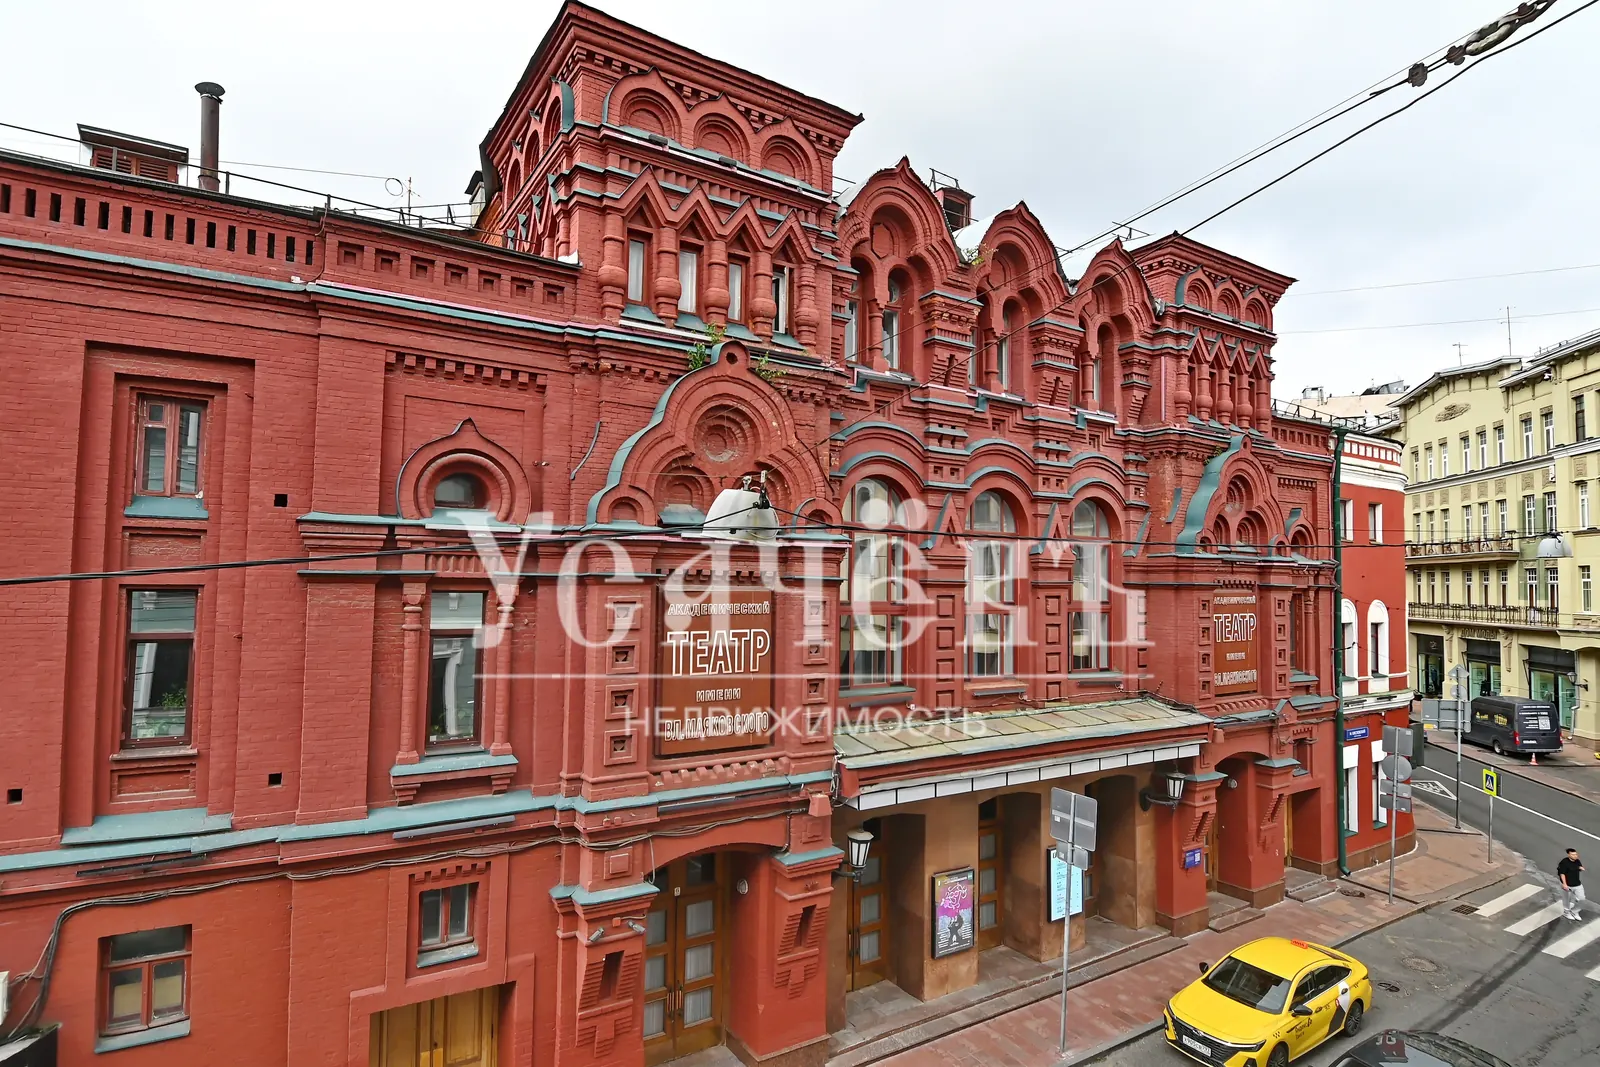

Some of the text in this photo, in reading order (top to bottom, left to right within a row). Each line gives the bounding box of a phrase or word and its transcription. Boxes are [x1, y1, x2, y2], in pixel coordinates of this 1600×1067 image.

[667, 601, 771, 617] АКАДЕМИЧЕСКИЙ
[1214, 613, 1256, 642] ТЕАТР
[666, 628, 771, 677] ТЕАТР
[696, 687, 742, 703] ИМЕНИ
